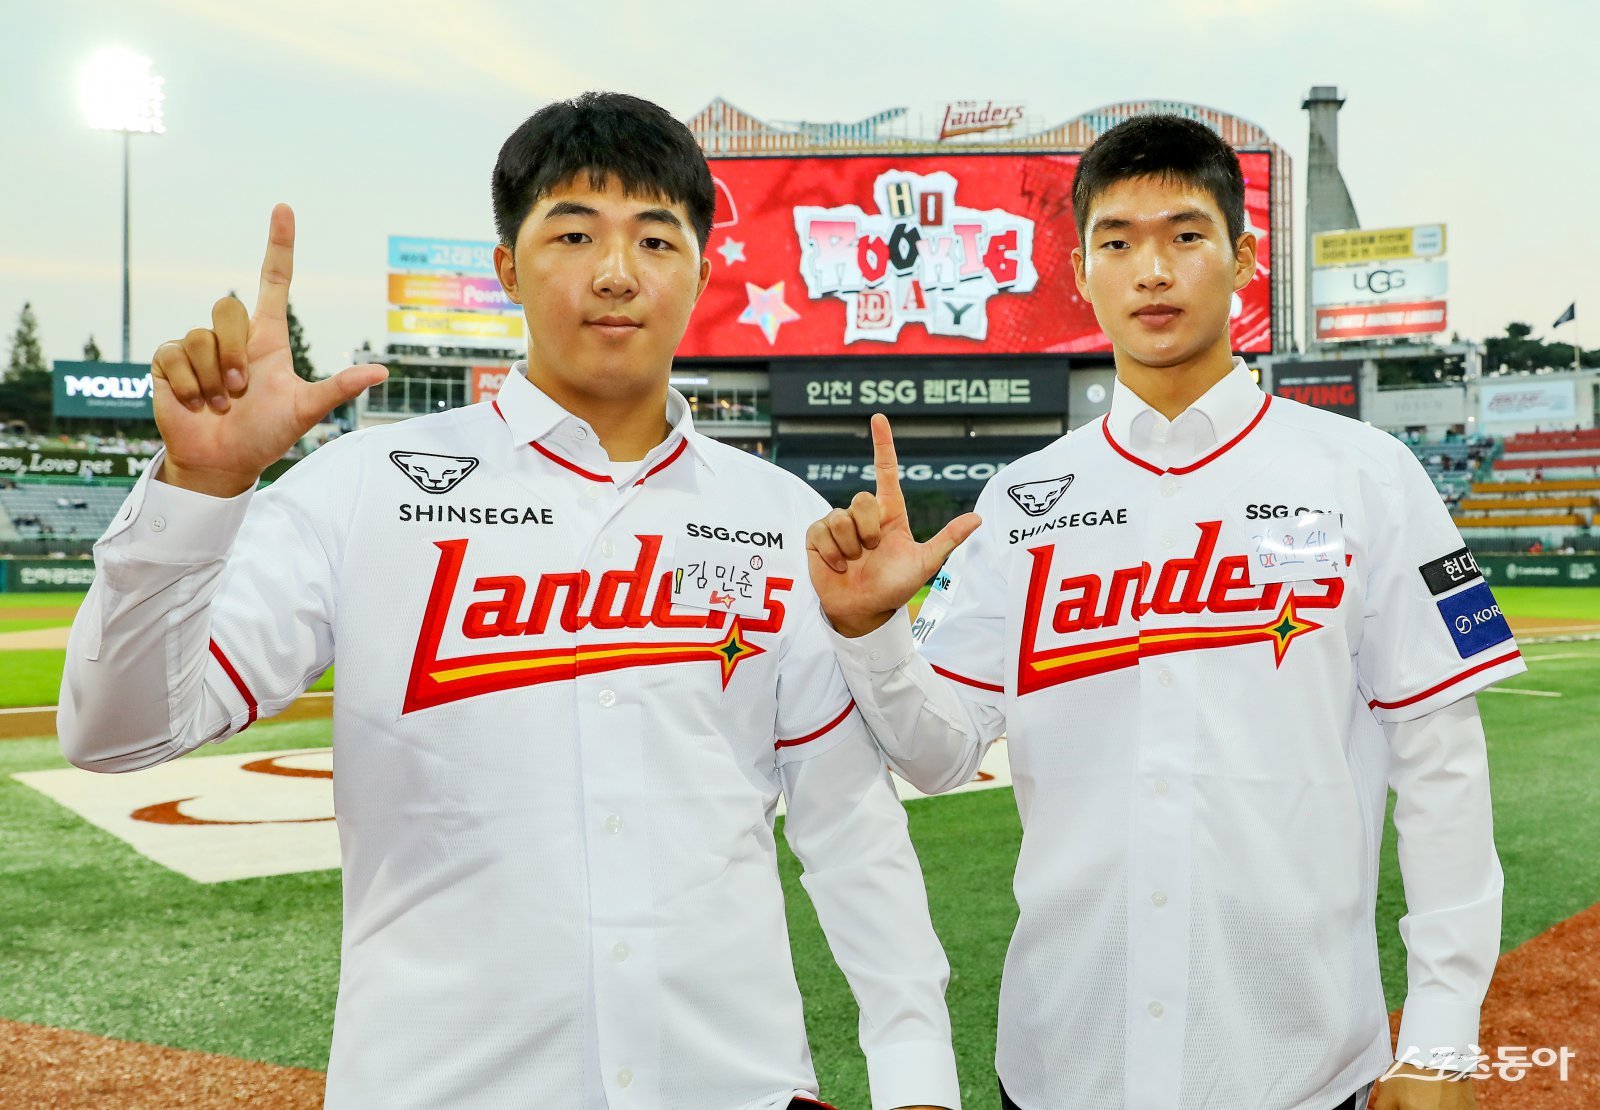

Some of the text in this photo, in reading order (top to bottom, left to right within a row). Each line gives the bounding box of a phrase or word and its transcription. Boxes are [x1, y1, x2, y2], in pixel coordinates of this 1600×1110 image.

[938, 101, 1025, 142] Landers
[809, 220, 1018, 288] ROOKIE
[1353, 269, 1406, 294] UGG
[857, 280, 974, 330] DAY
[806, 379, 1031, 405] 인천 SSG 랜더스필드
[399, 503, 554, 526] SHINSEGAE
[1008, 508, 1128, 545] SHINSEGAE
[686, 522, 784, 550] SSG.COM
[687, 560, 753, 599] 김민준
[1472, 604, 1502, 625] KOR
